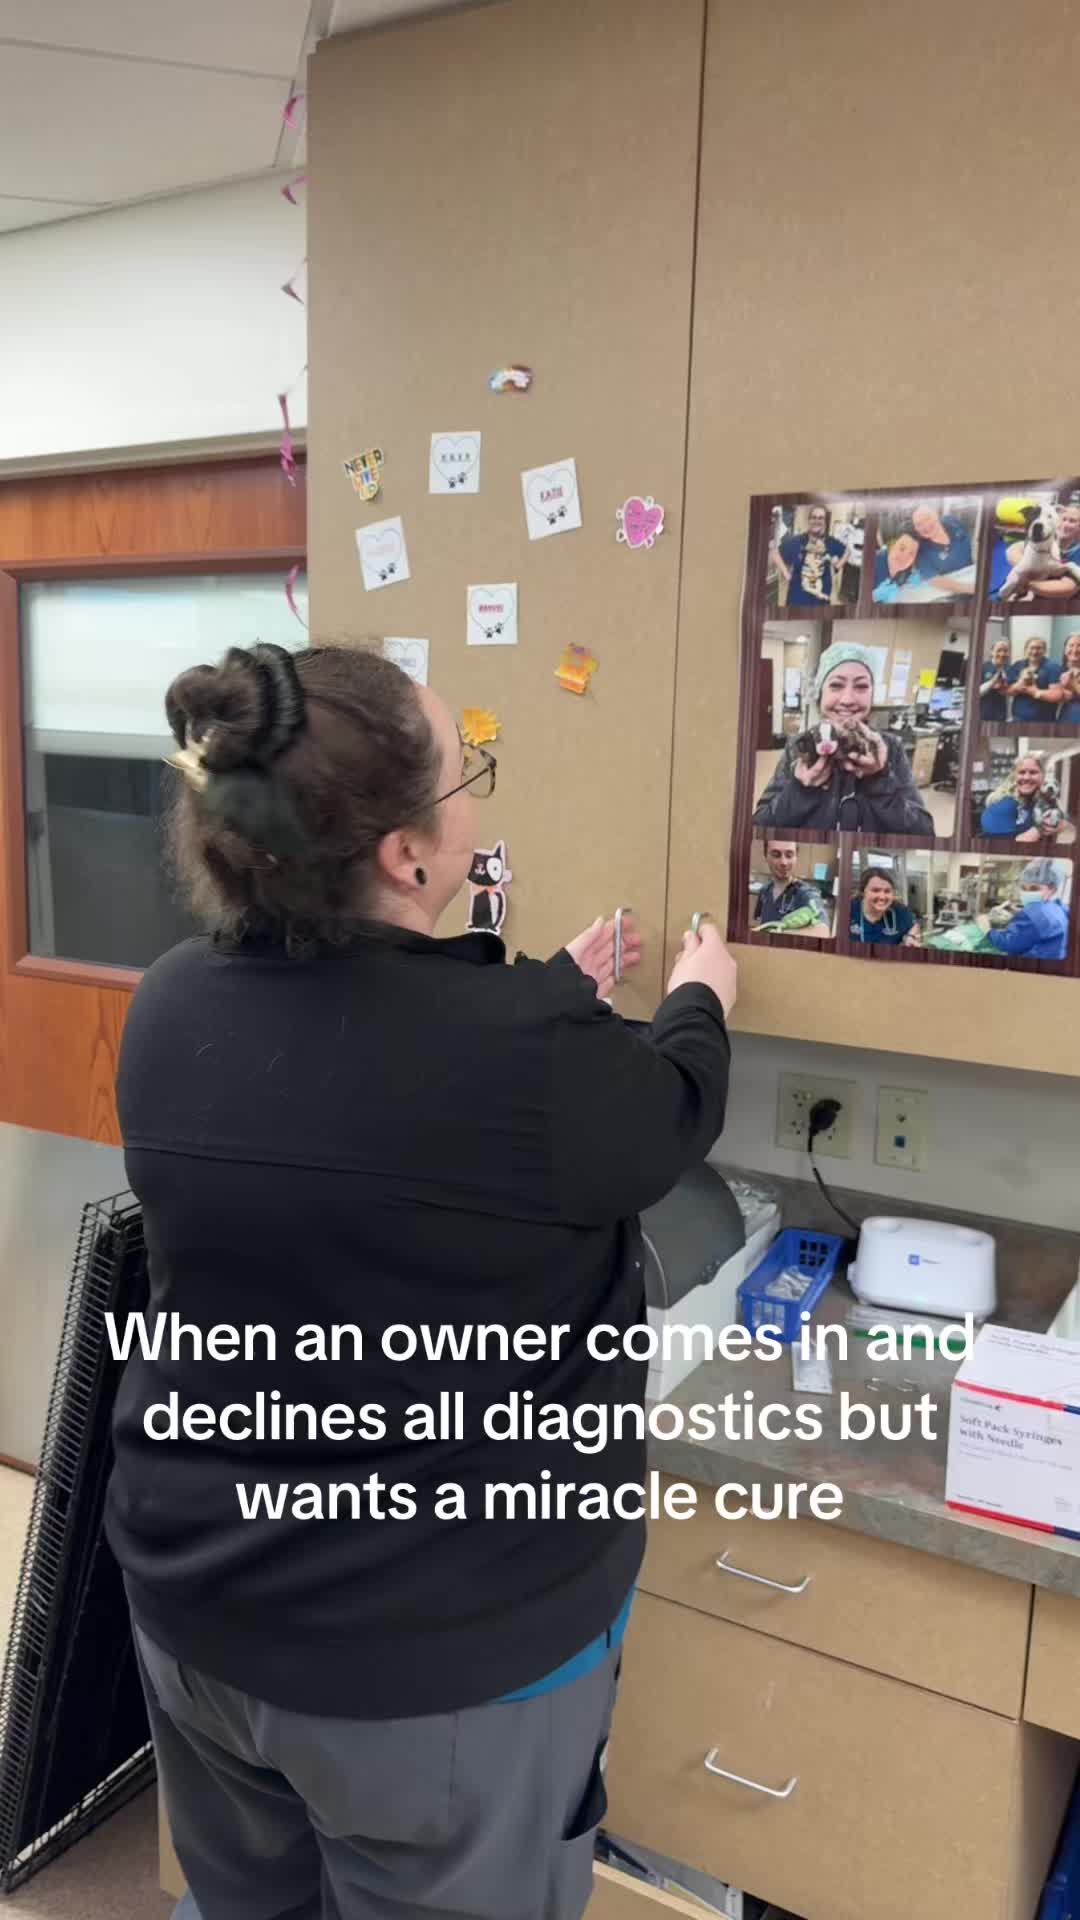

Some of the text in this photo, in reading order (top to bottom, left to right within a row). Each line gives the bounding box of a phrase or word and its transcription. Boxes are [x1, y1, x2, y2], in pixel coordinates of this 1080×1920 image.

[959, 1416, 1063, 1446] Soft Pack Syringes
[959, 1428, 1024, 1449] with Needle
